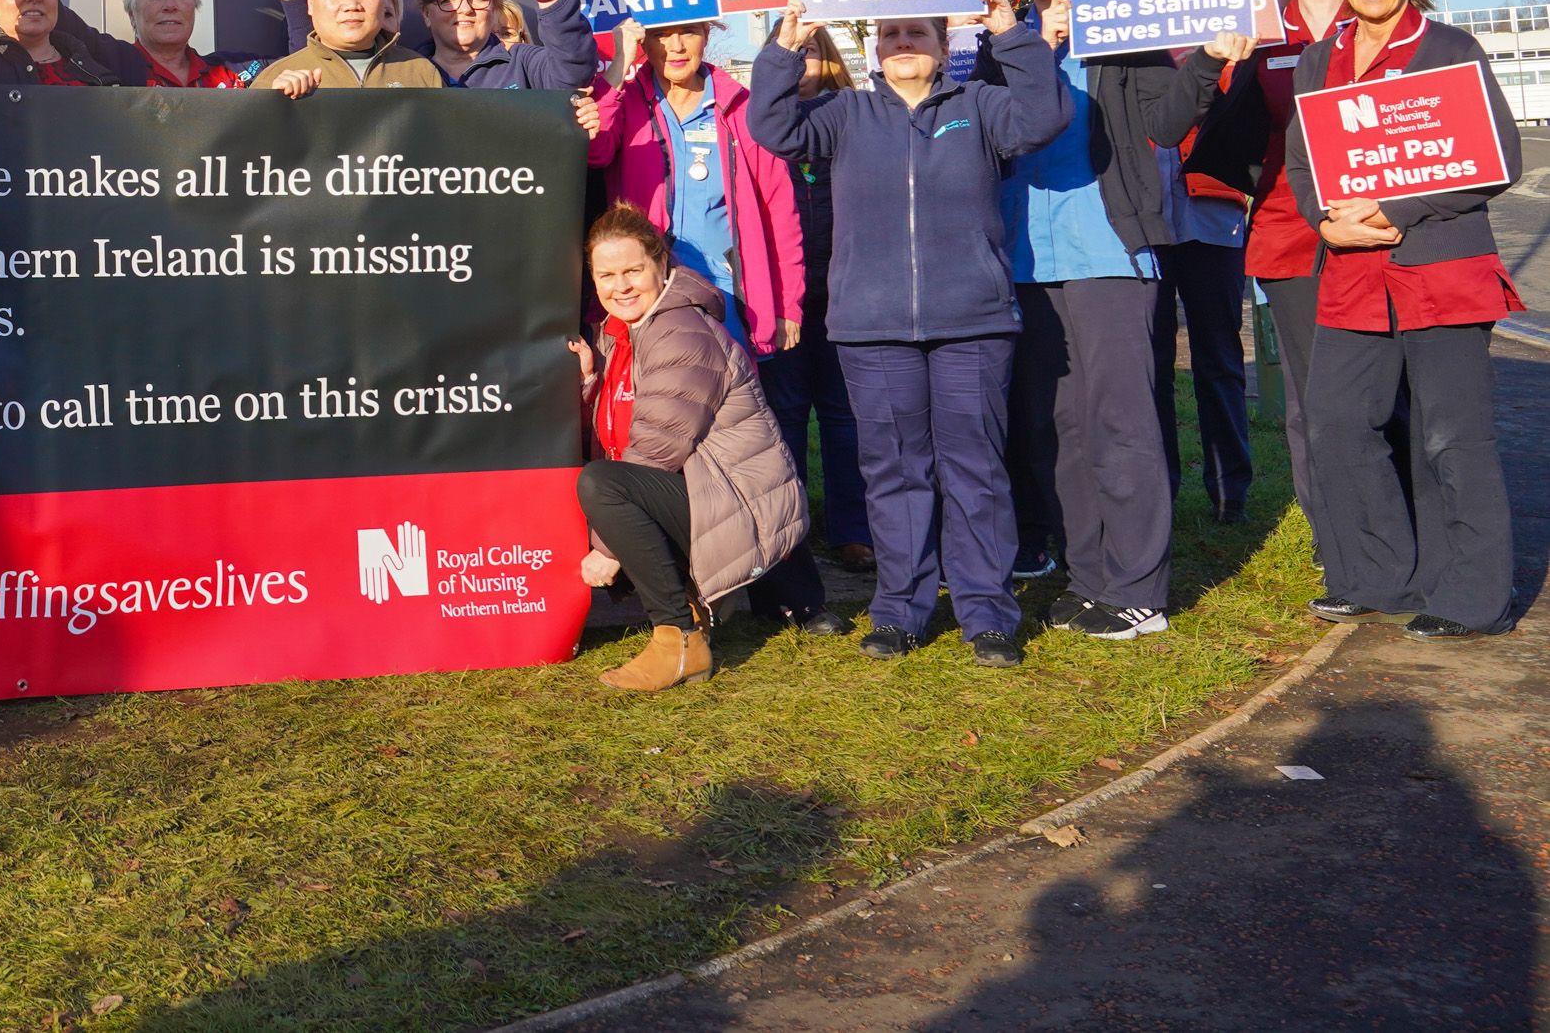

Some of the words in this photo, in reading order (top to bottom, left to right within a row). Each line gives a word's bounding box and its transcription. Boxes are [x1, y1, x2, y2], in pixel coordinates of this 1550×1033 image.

[1076, 1, 1132, 22] Safe
[1086, 23, 1160, 44] Saves
[1168, 16, 1237, 36] Lives
[1380, 101, 1405, 115] Royal
[1406, 96, 1441, 108] College
[1382, 116, 1392, 125] of
[1394, 110, 1430, 122] Nursing
[1385, 124, 1416, 135] Northern
[1417, 120, 1441, 130] Ireland
[1347, 144, 1398, 168] Fair
[1403, 137, 1454, 159] Pay
[26, 155, 159, 198] makes
[175, 157, 228, 197] all
[243, 157, 311, 196] the
[326, 155, 545, 196] difference.
[1339, 175, 1378, 194] for
[1383, 160, 1477, 188] Nurses
[93, 235, 244, 278] Ireland
[261, 235, 295, 277] is
[309, 234, 473, 282] missing
[40, 384, 113, 429] call
[126, 384, 221, 426] time
[234, 390, 286, 422] on
[300, 375, 380, 419] this
[393, 374, 512, 416] crisis.
[437, 547, 484, 572] Royal
[487, 544, 552, 568] College
[438, 572, 457, 594] of
[461, 570, 528, 597] Nursing
[441, 601, 500, 617] Northern
[502, 597, 546, 615] Ireland
